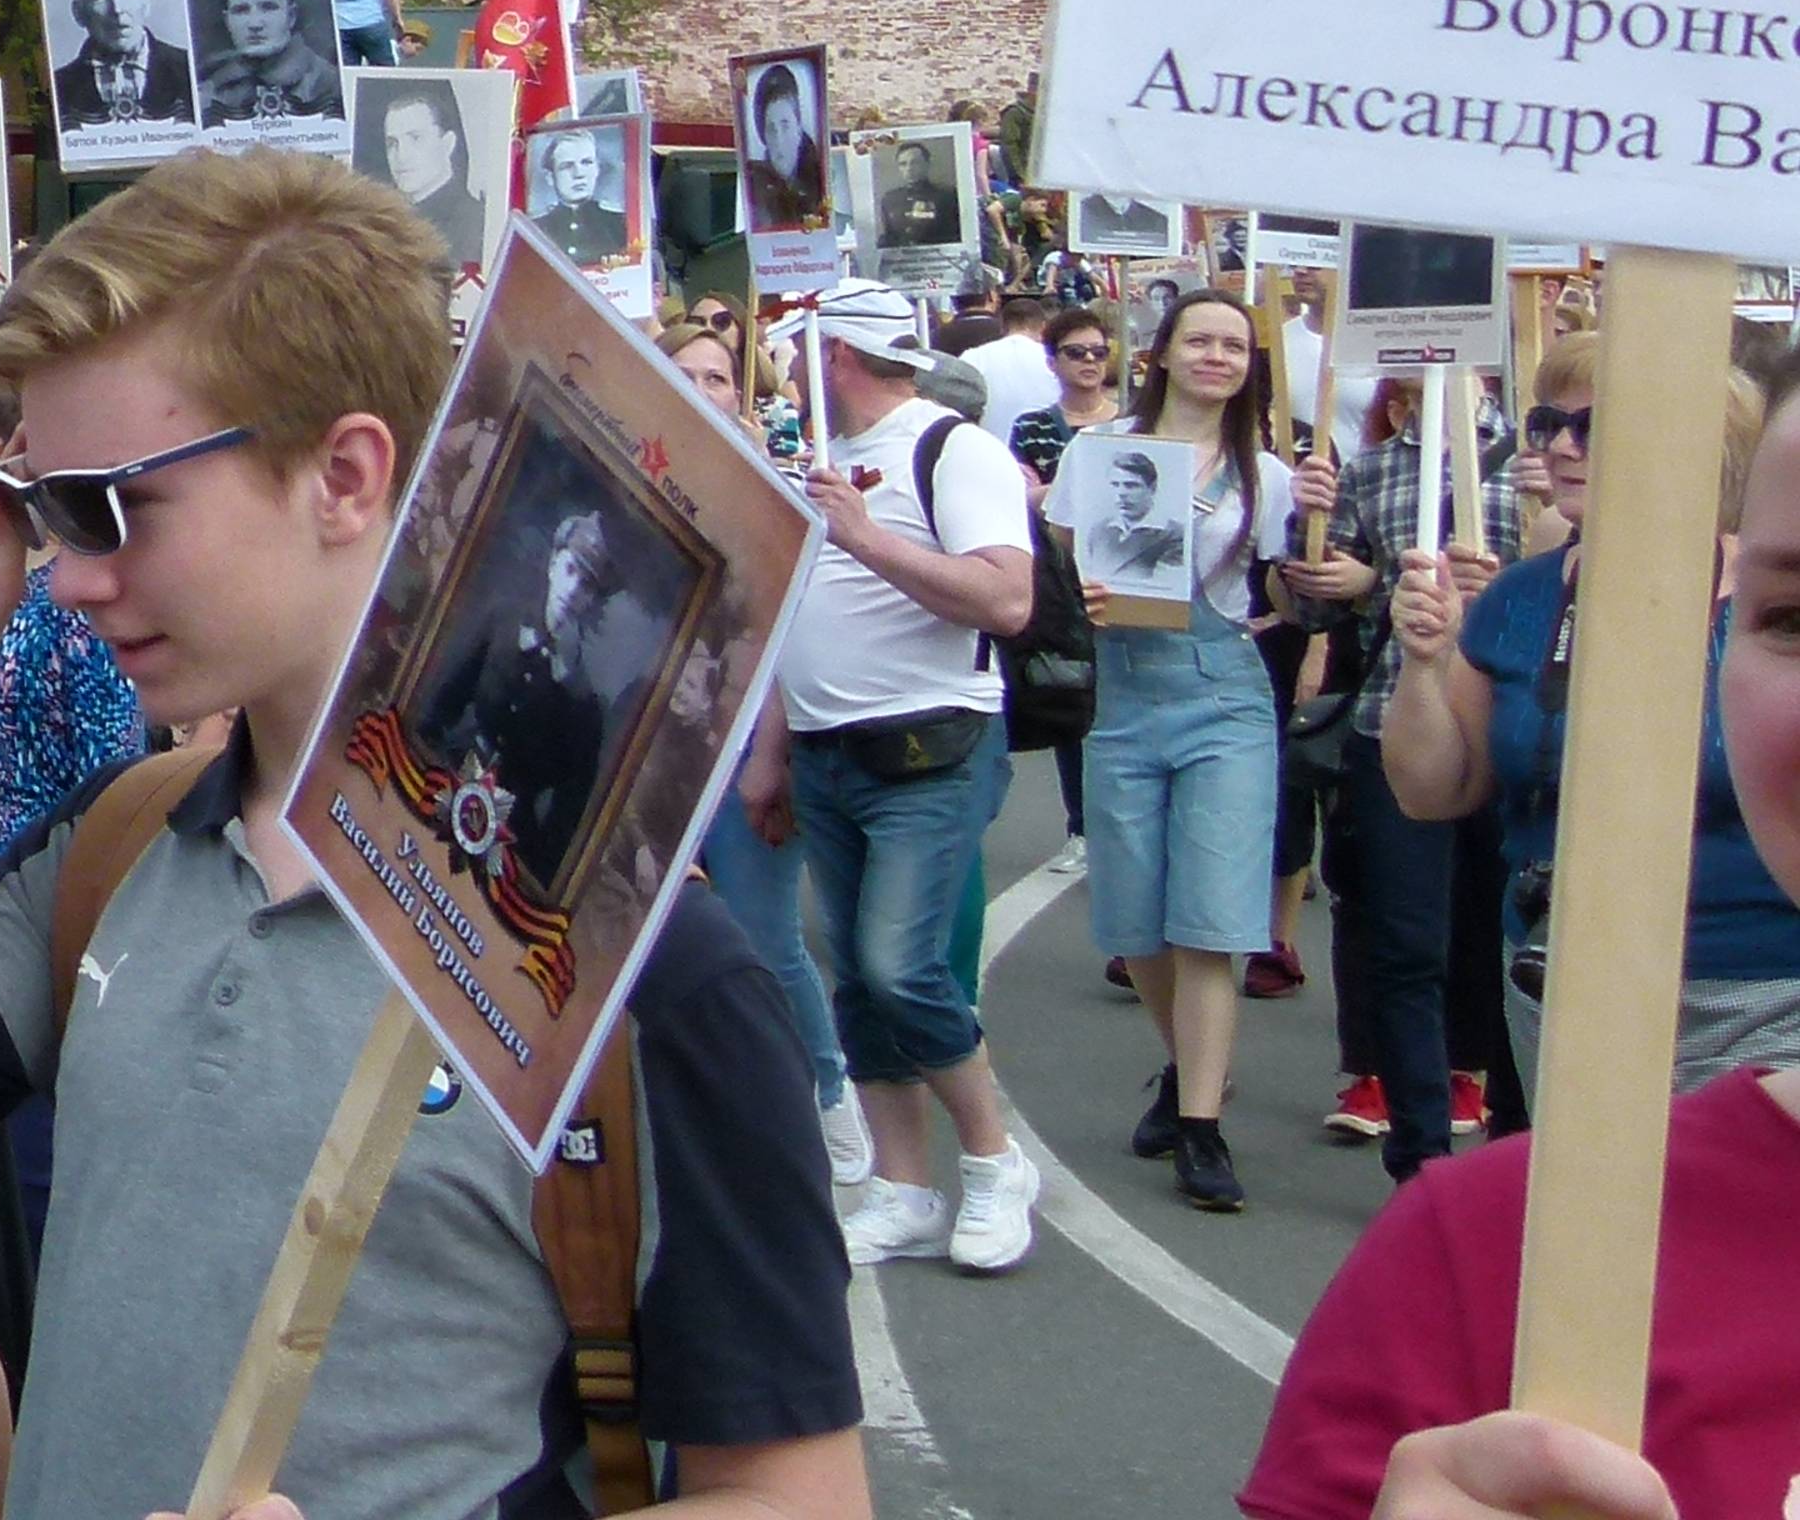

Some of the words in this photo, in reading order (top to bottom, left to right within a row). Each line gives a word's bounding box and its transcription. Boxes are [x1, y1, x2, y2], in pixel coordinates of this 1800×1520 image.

[1127, 46, 1662, 173] Александра
[329, 792, 418, 918] Василий
[413, 910, 534, 1070] Борисович
[397, 830, 484, 959] Ульянов
